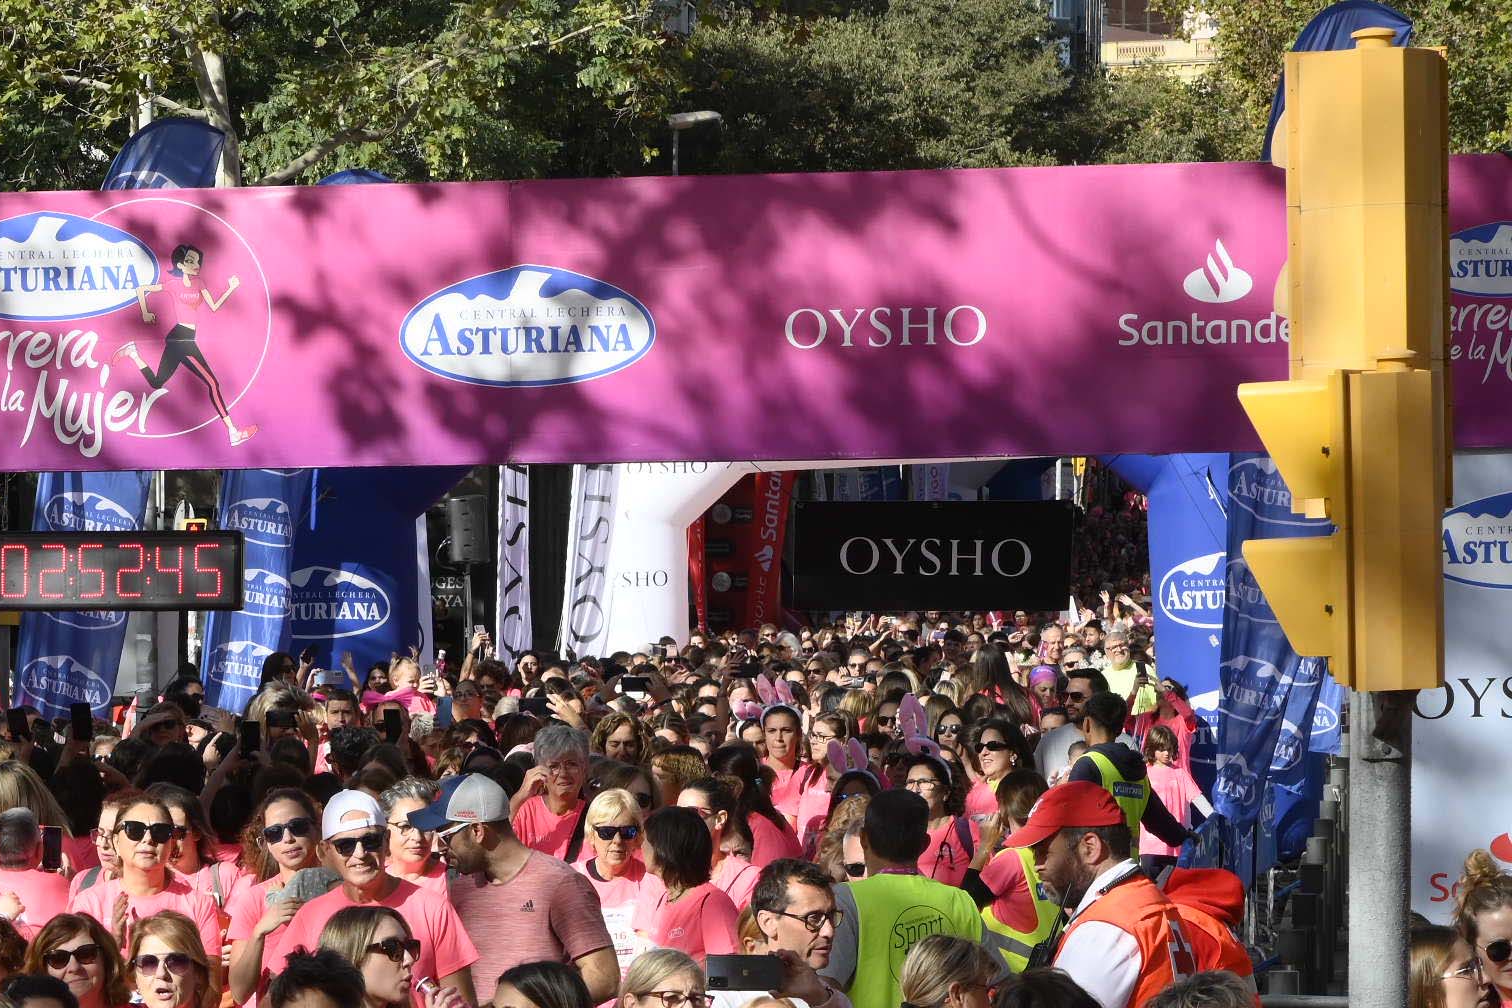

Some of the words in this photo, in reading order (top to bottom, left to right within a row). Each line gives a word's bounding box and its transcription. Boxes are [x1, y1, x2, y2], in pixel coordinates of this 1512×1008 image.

[62, 247, 135, 261] LECHERA
[459, 307, 536, 319] CENTRAL
[545, 306, 626, 318] LECHERA
[784, 304, 988, 350] OYSHO
[1118, 313, 1288, 346] Santande
[420, 312, 634, 356] ASTURIANA
[1, 375, 25, 413] la
[20, 364, 169, 458] Mujer
[1233, 472, 1291, 507] ASTUR
[49, 506, 137, 531] ASTURIAN
[570, 465, 612, 644] OYSH
[840, 536, 1032, 577] OYSHO
[1441, 529, 1512, 566] ASTU
[0, 543, 222, 599] 02:52:45
[616, 570, 668, 588] SHO
[1183, 579, 1225, 588] CENTRA
[327, 591, 377, 599] LECHERA
[1166, 581, 1226, 610] ASTU
[26, 671, 102, 704] ASTURIANA
[894, 916, 943, 954] Sport
